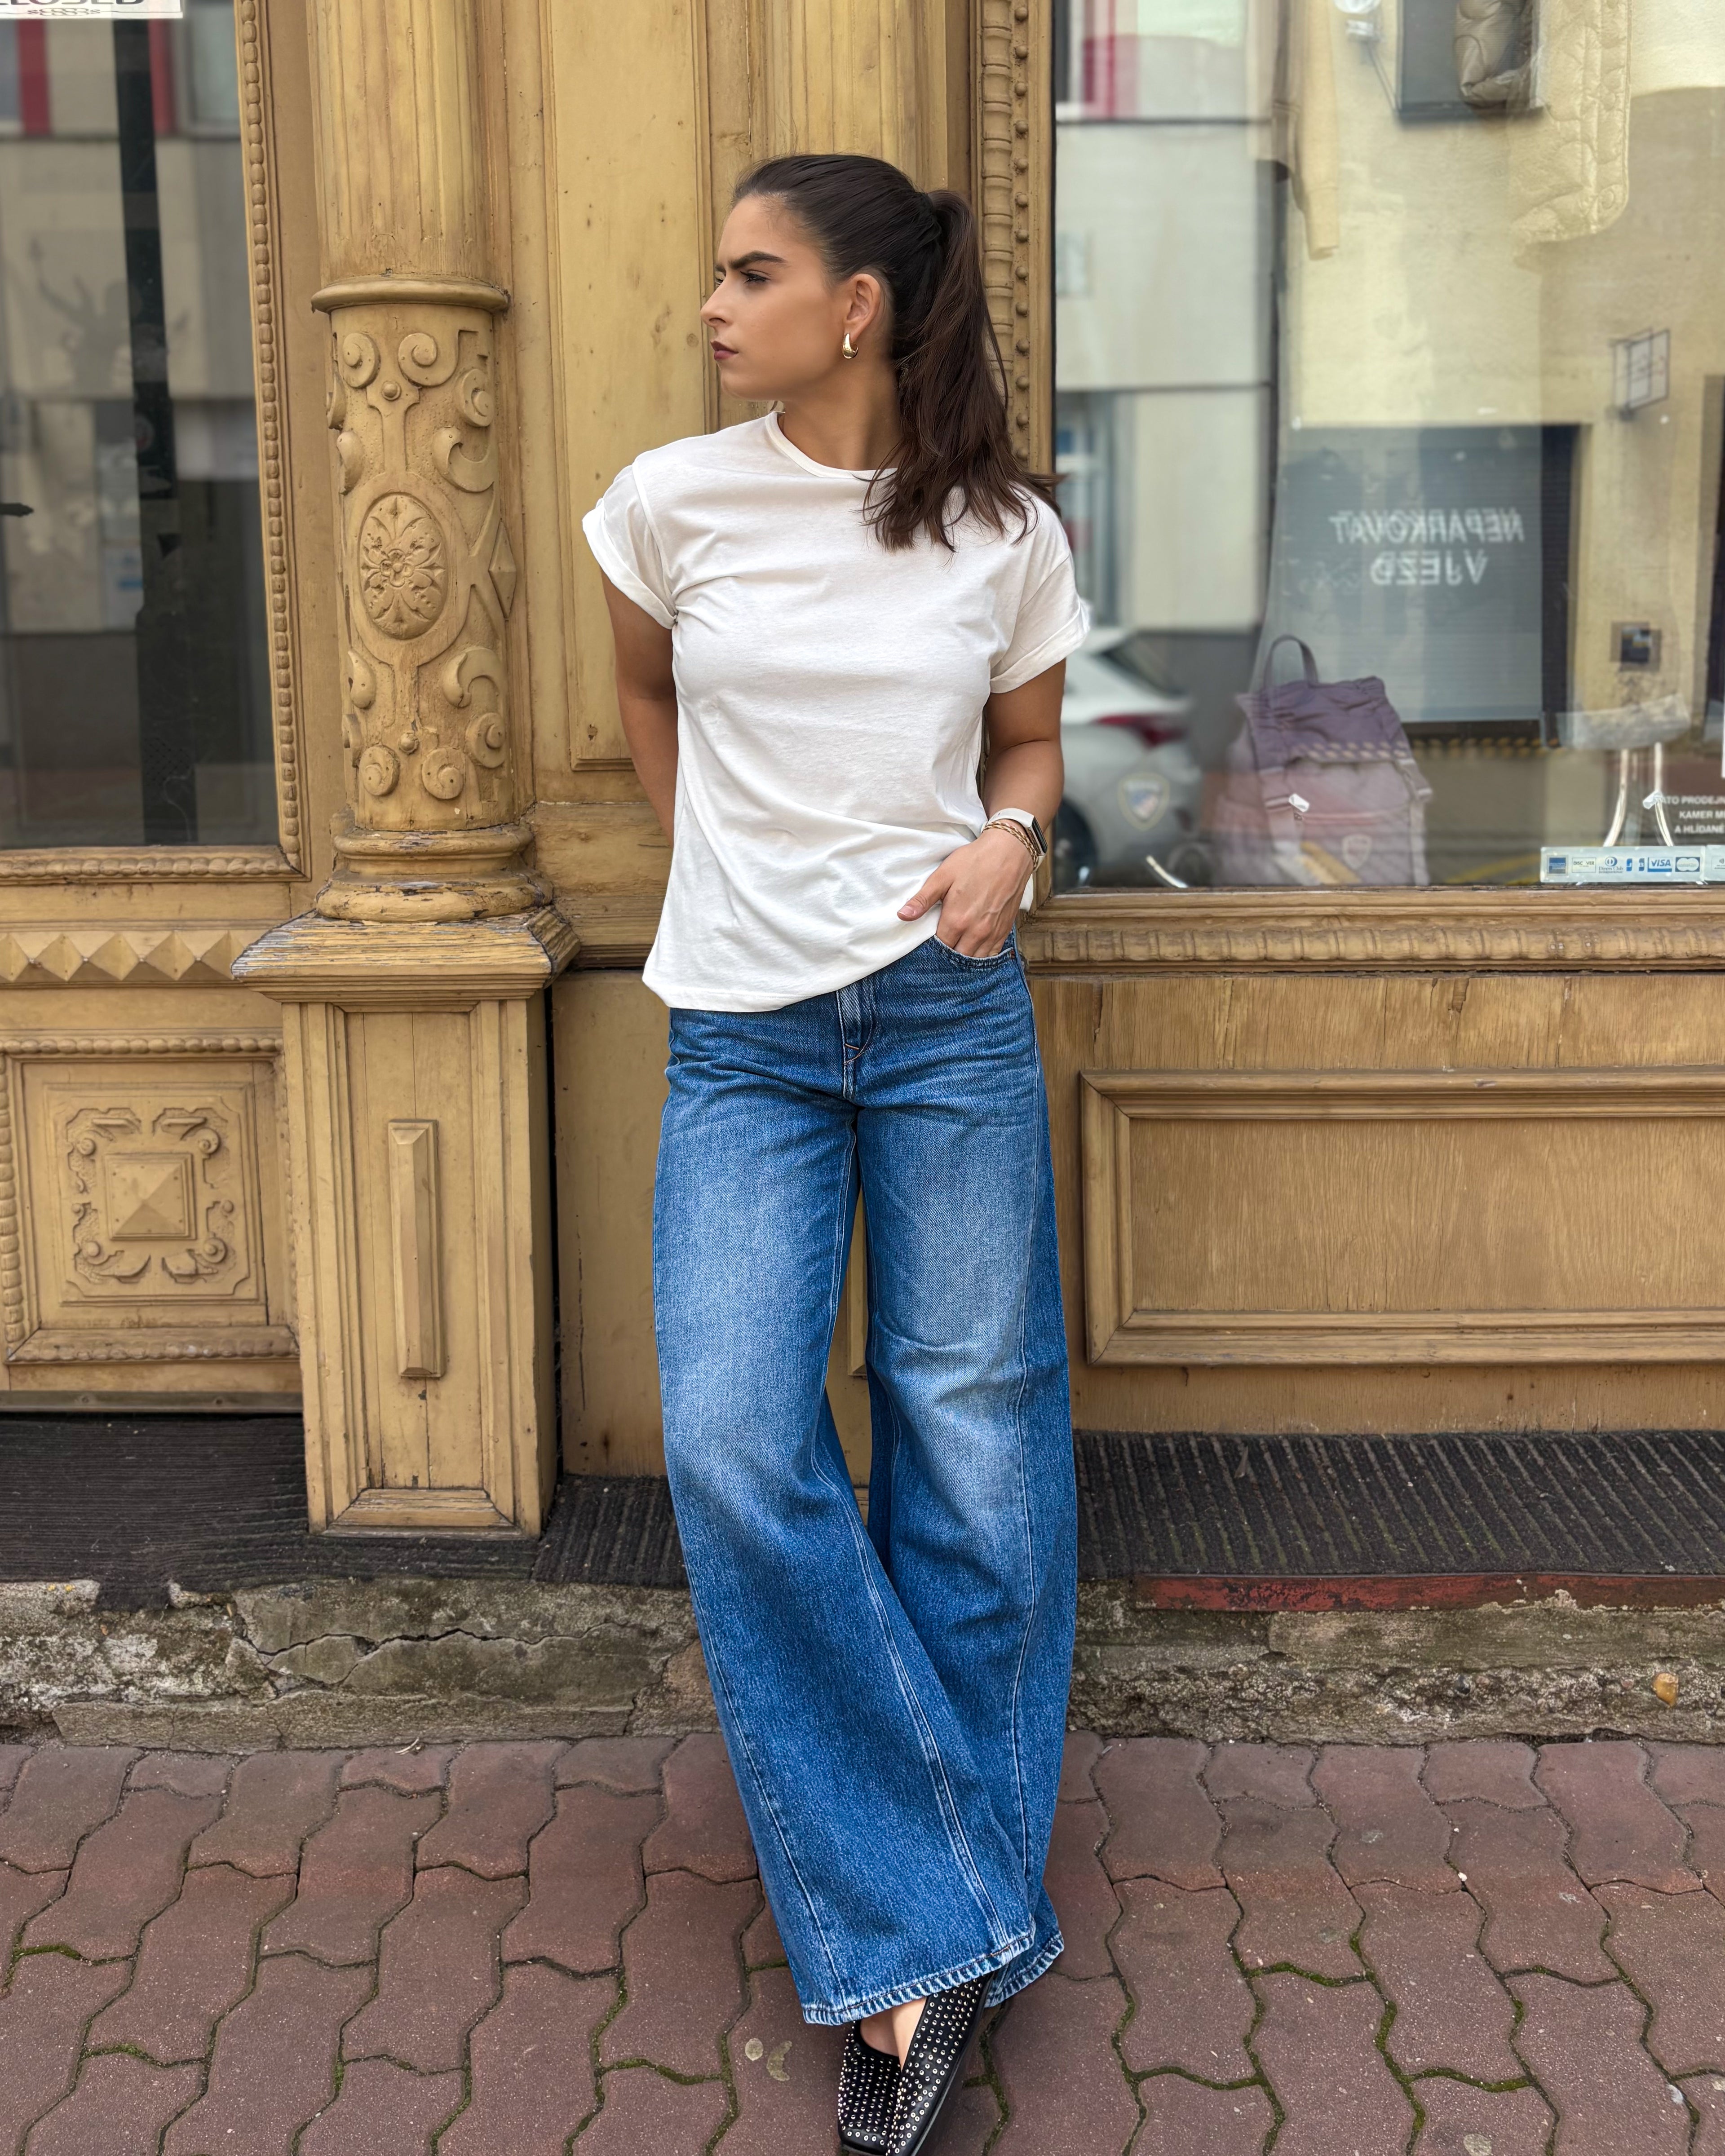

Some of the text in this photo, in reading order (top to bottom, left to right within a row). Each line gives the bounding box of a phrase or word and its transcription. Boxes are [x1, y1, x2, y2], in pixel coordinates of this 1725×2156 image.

[1679, 811, 1725, 819] KAMER M
[1684, 823, 1725, 834] HLÍDANÉ
